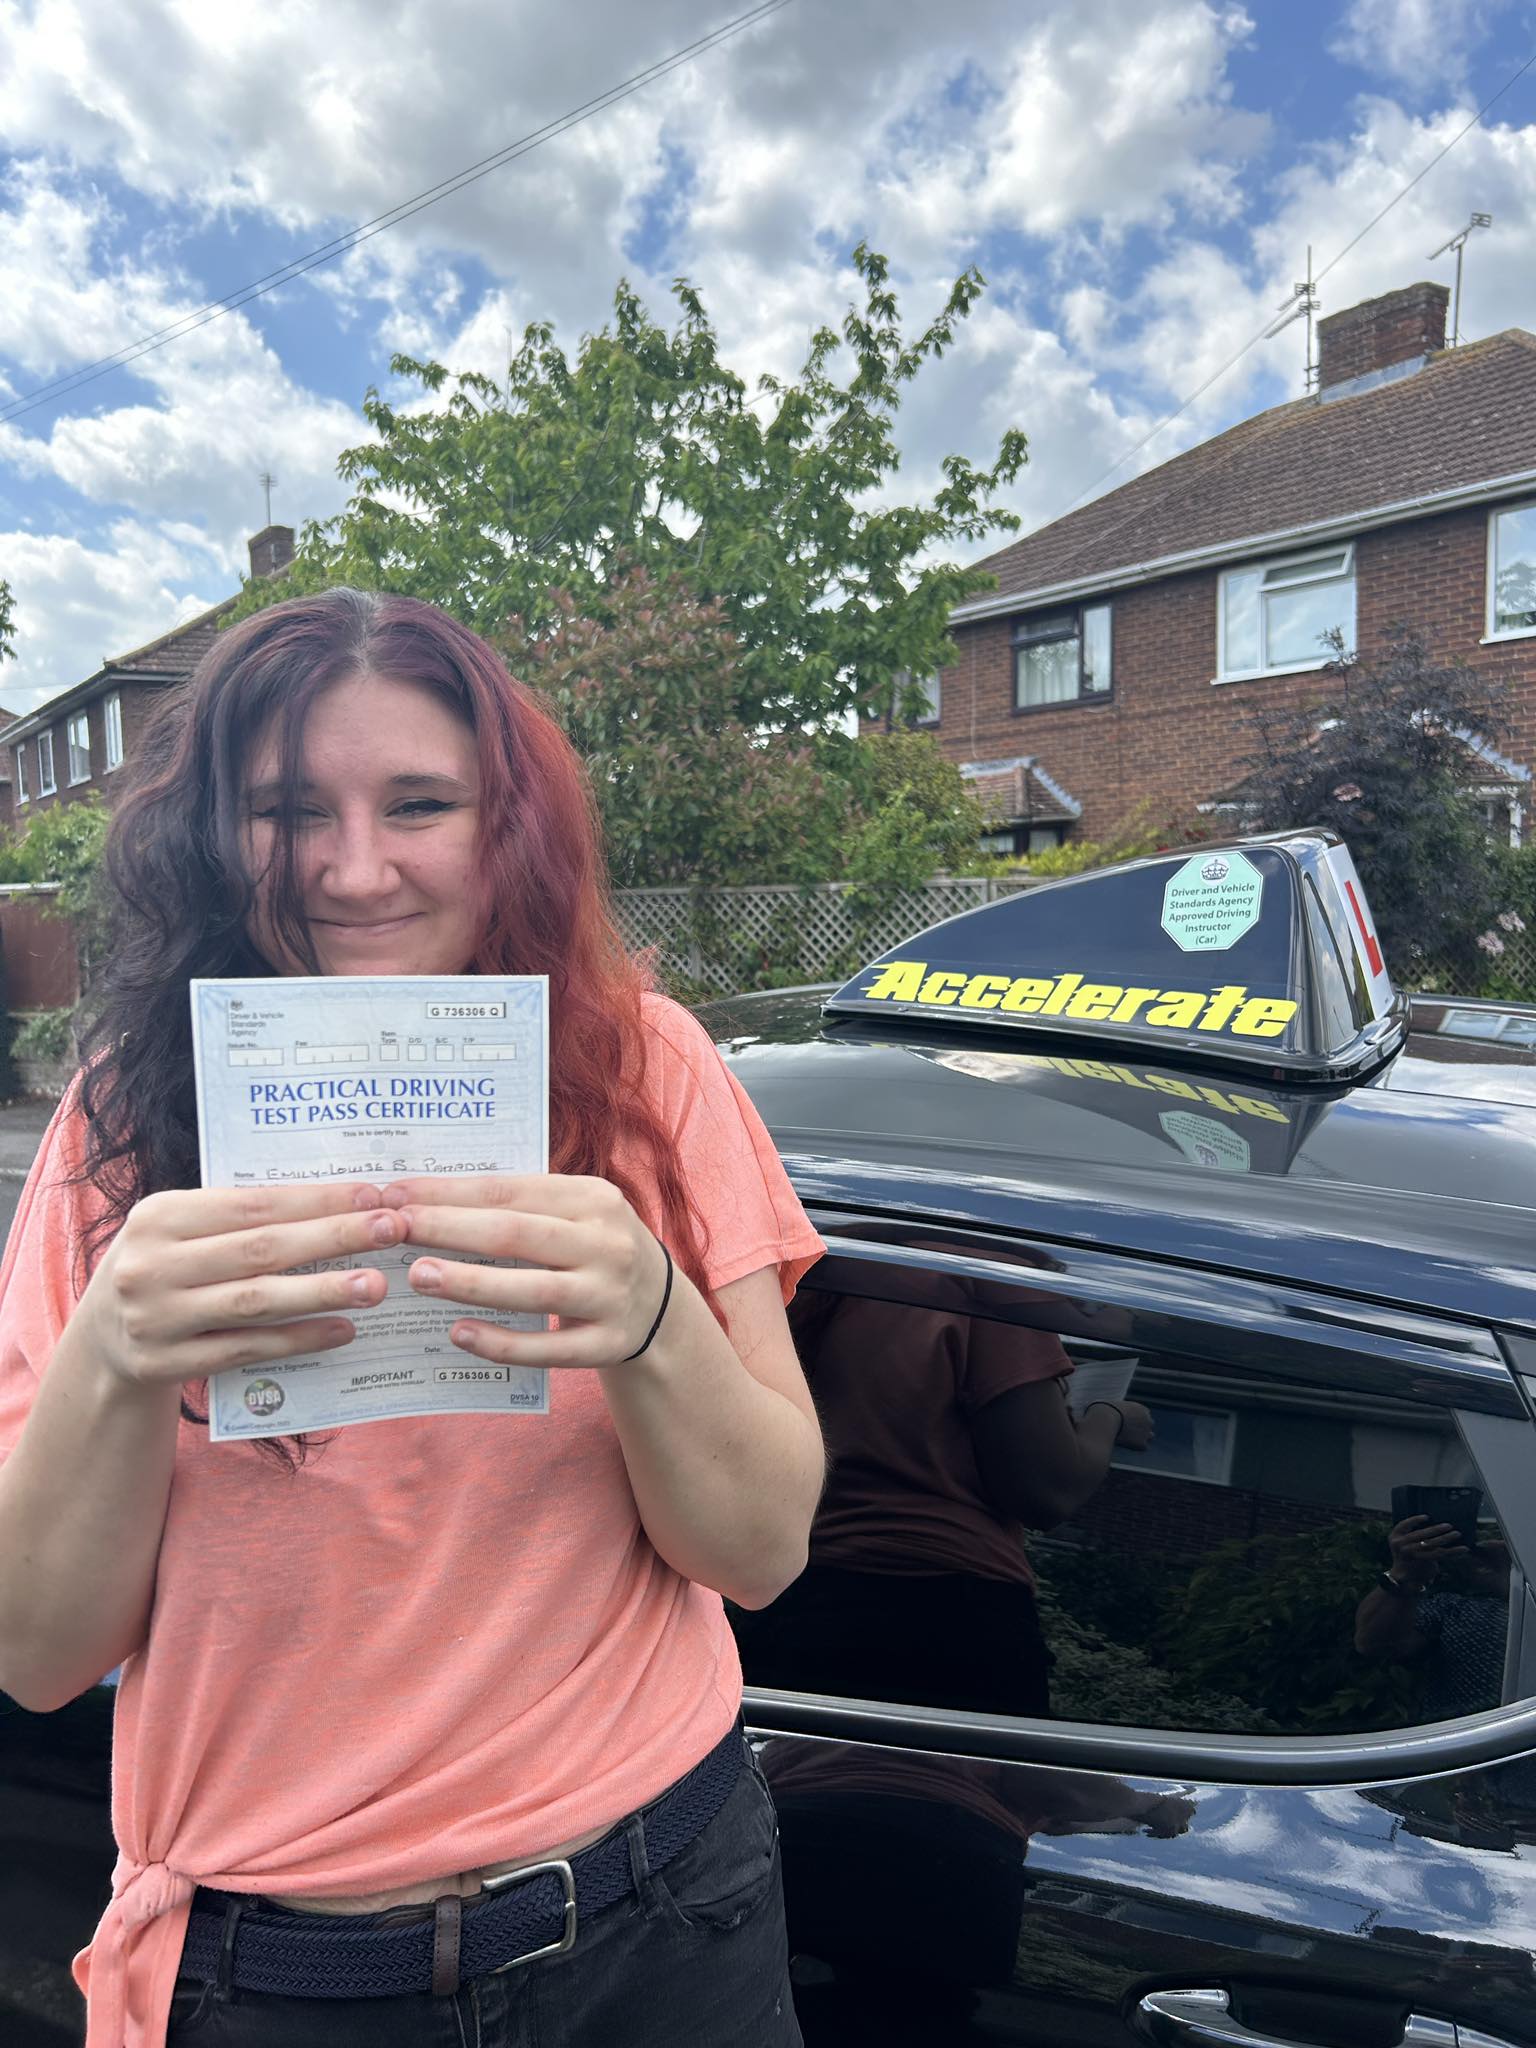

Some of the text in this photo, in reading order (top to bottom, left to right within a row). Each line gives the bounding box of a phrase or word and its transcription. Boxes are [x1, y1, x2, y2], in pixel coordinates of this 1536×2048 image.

[1171, 883, 1255, 897] Driver and Vehicle
[1169, 896, 1254, 909] Standards Agency
[1168, 909, 1252, 923] Approved Driving
[1185, 923, 1231, 933] Instructor
[1195, 935, 1218, 945] (Car)
[861, 960, 1298, 1038] Accelerate
[431, 1007, 440, 1016] G
[444, 1007, 486, 1016] 736306
[251, 1078, 495, 1103] PRACTICAL DRIVING
[250, 1101, 496, 1125] TEST PASS CERTIFICATE
[352, 1370, 414, 1386] IMPORTANT
[439, 1372, 447, 1380] G
[451, 1372, 490, 1380] 736306
[248, 1390, 282, 1406] DVSA
